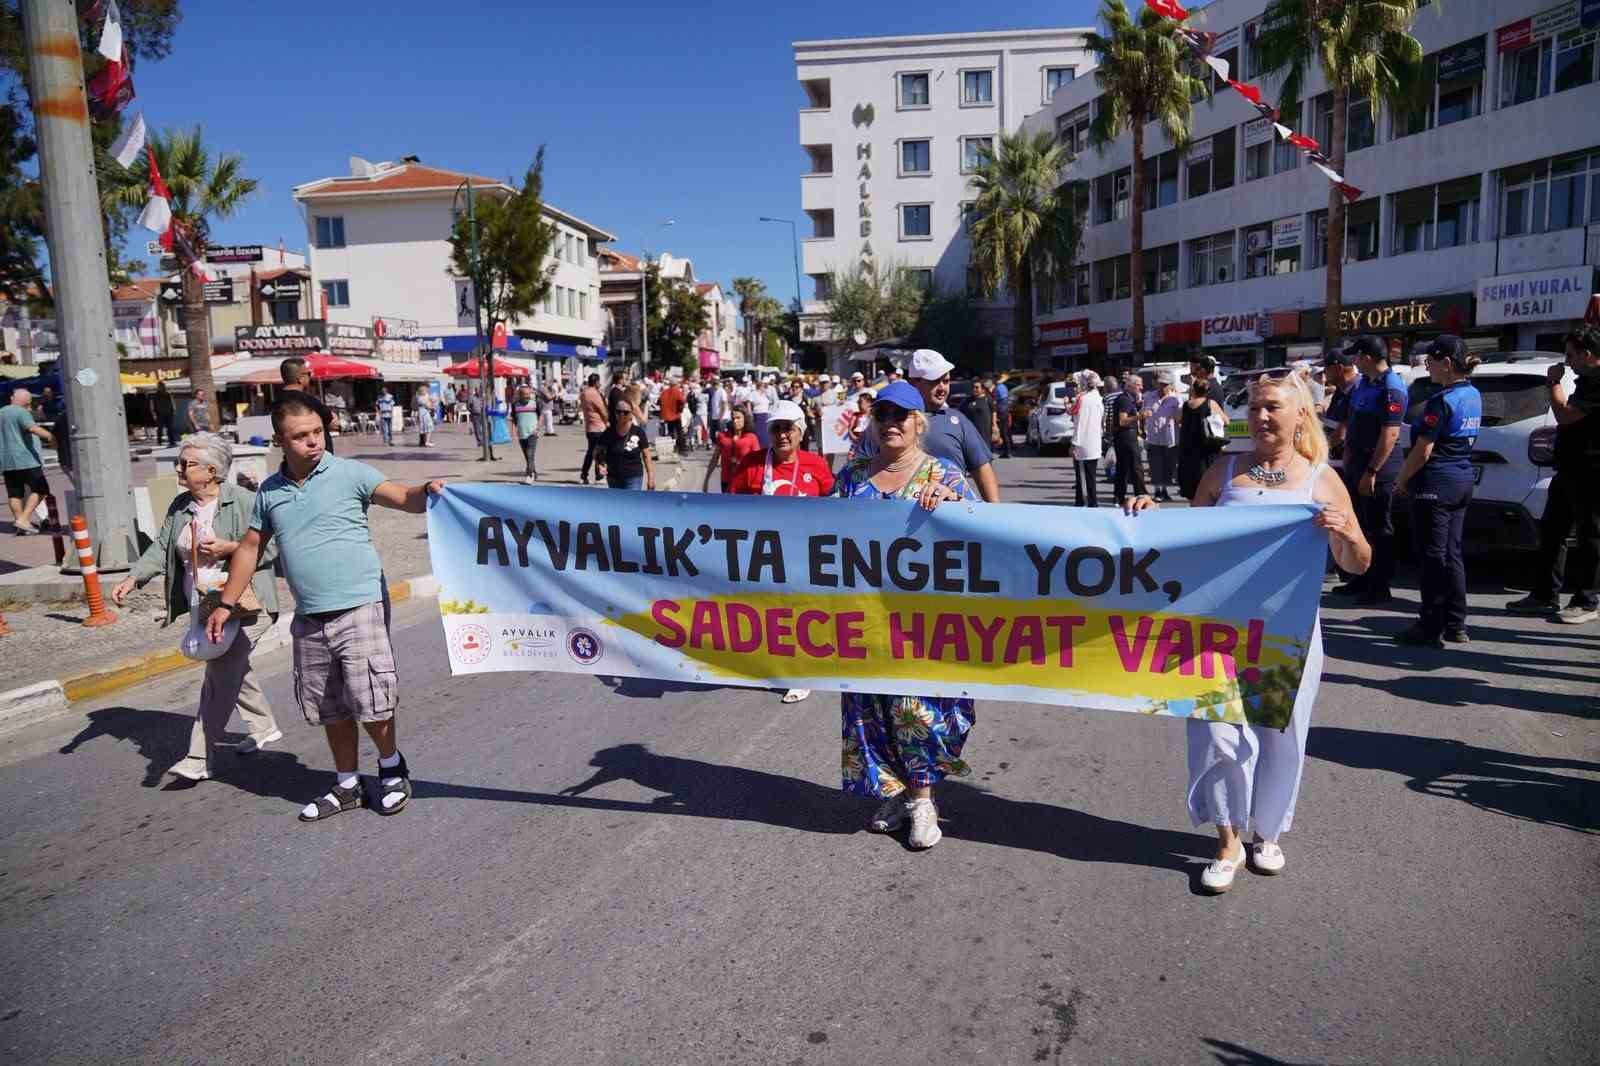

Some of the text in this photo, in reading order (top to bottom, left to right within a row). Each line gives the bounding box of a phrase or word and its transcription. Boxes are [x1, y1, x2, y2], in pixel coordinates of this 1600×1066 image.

[856, 142, 876, 290] HALKBAN
[1529, 276, 1583, 297] VURAL
[1367, 300, 1432, 328] OPTİK
[1503, 298, 1553, 318] PASAJI
[808, 534, 1000, 594] ENGEL
[1023, 543, 1182, 603] YOK,
[502, 628, 556, 638] AYVALIK
[651, 599, 867, 660] SADECE
[889, 612, 1086, 668] HAYAT
[1109, 614, 1264, 682] VAR!
